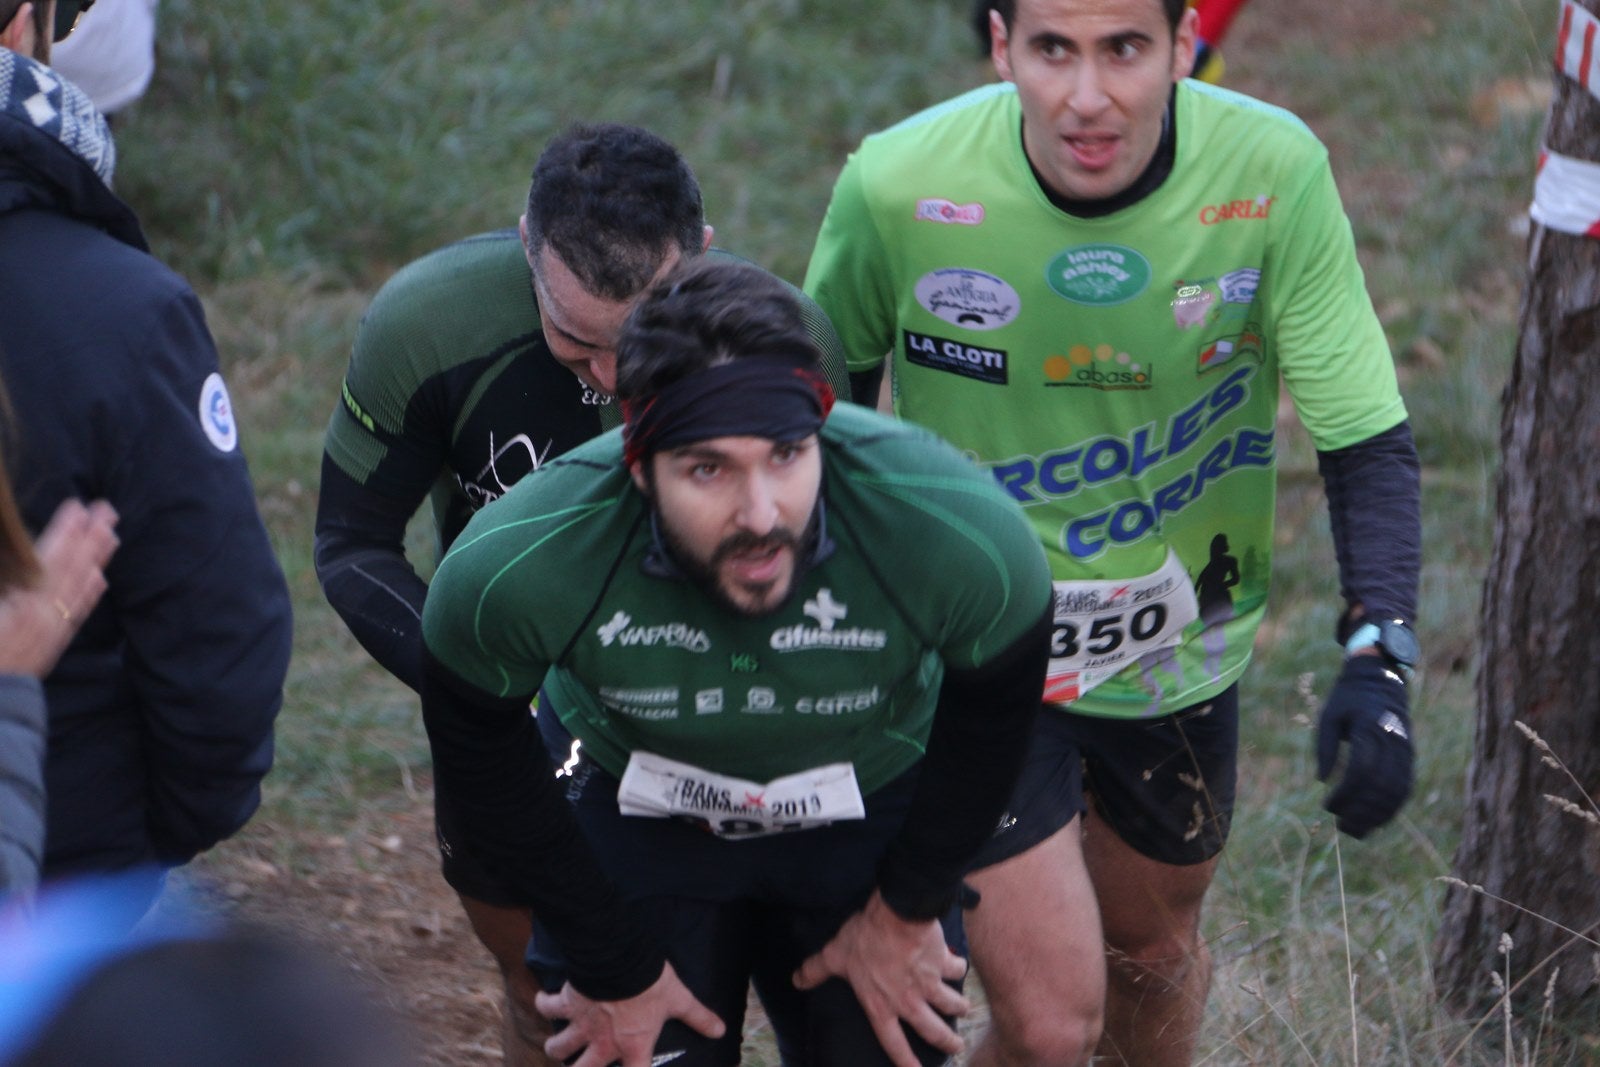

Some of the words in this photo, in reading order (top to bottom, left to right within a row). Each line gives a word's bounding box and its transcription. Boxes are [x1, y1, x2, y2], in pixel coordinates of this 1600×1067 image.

[1062, 262, 1130, 282] ashley
[1066, 249, 1125, 264] laura
[909, 334, 937, 354] LA
[942, 341, 1003, 369] CLOTI
[1076, 361, 1152, 383] abasol
[992, 363, 1255, 503] RCOLES
[1062, 427, 1276, 562] CORRE
[1051, 602, 1168, 659] 350
